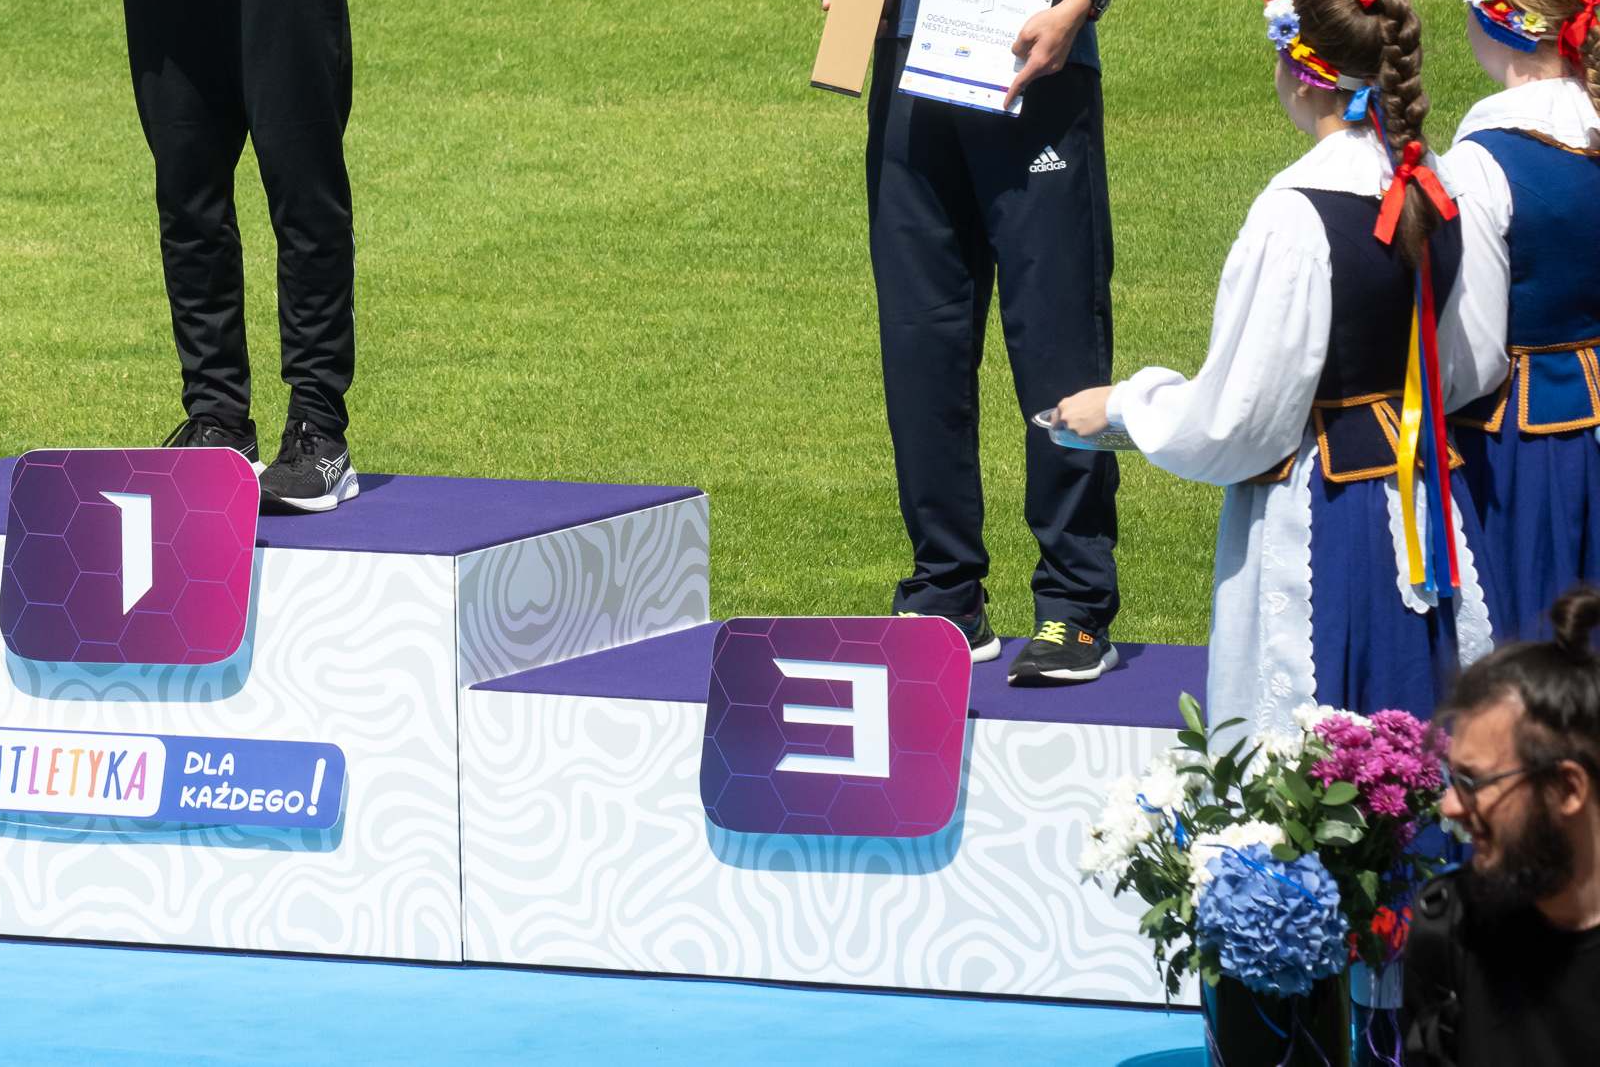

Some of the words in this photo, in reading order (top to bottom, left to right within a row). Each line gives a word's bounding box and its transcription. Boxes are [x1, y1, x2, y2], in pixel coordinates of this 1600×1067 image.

[927, 13, 994, 34] OGÓLNOPOLSKIM
[951, 27, 967, 37] CUP
[1029, 159, 1066, 173] adidas
[99, 491, 153, 615] 1
[772, 658, 889, 778] 3
[184, 751, 235, 777] DLA
